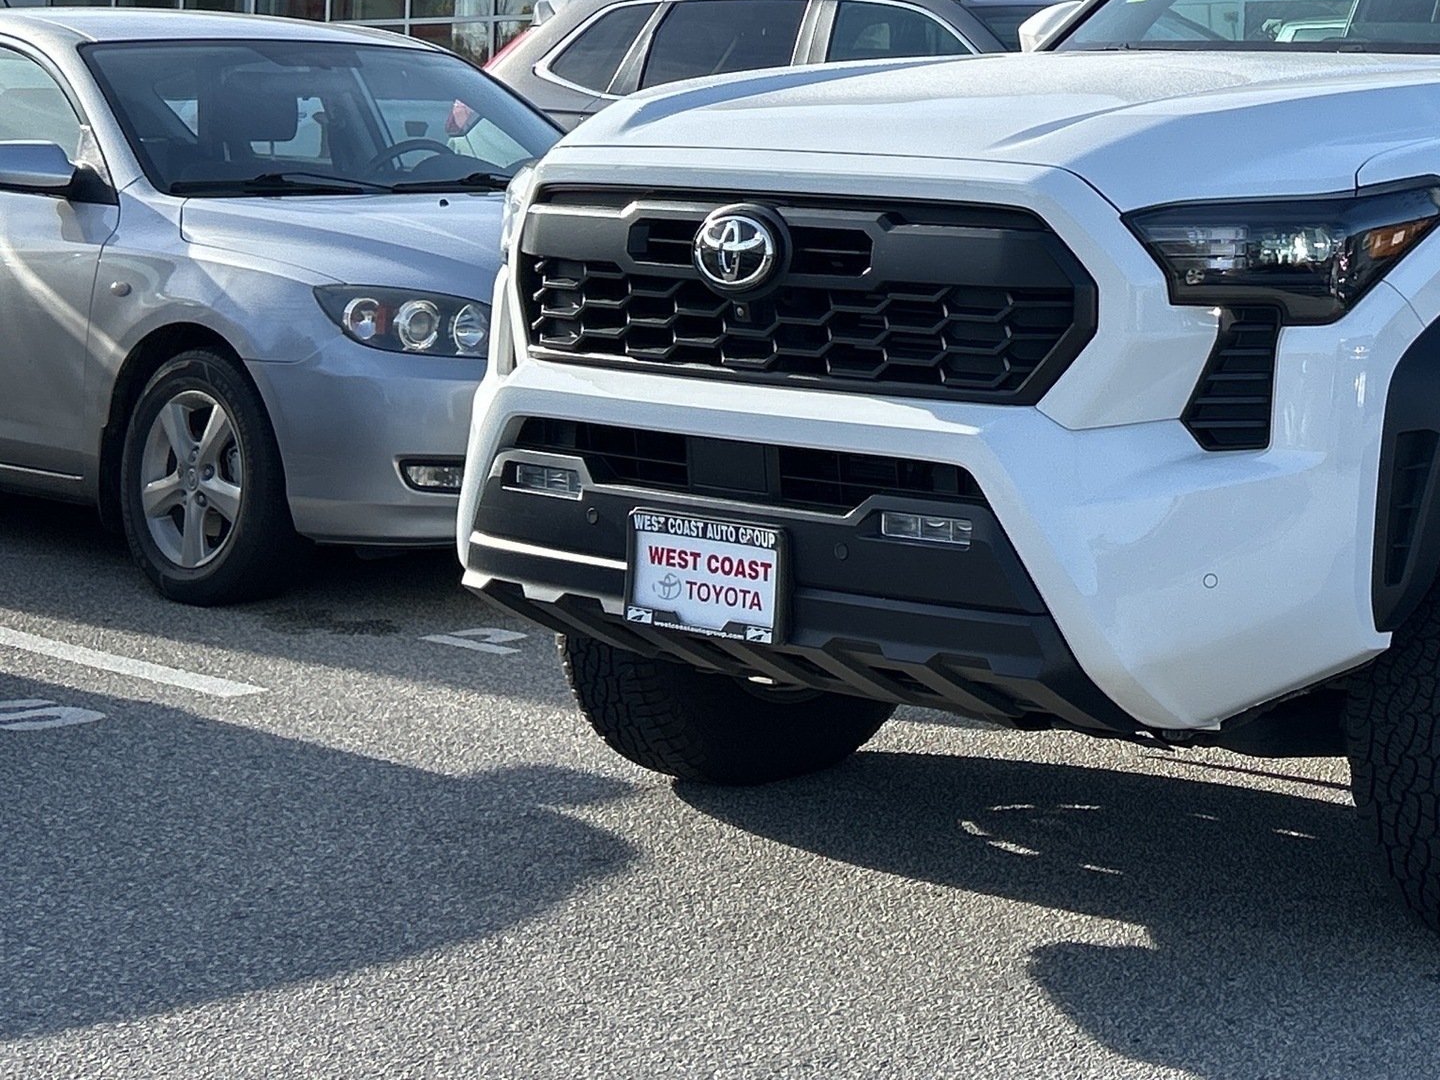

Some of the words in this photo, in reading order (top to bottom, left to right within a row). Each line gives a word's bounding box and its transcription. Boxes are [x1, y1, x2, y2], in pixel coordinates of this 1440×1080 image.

[667, 517, 704, 538] COAST
[706, 523, 736, 542] AUTO
[648, 545, 702, 571] WEST
[707, 554, 772, 582] COAST
[685, 580, 763, 612] TOYOTA
